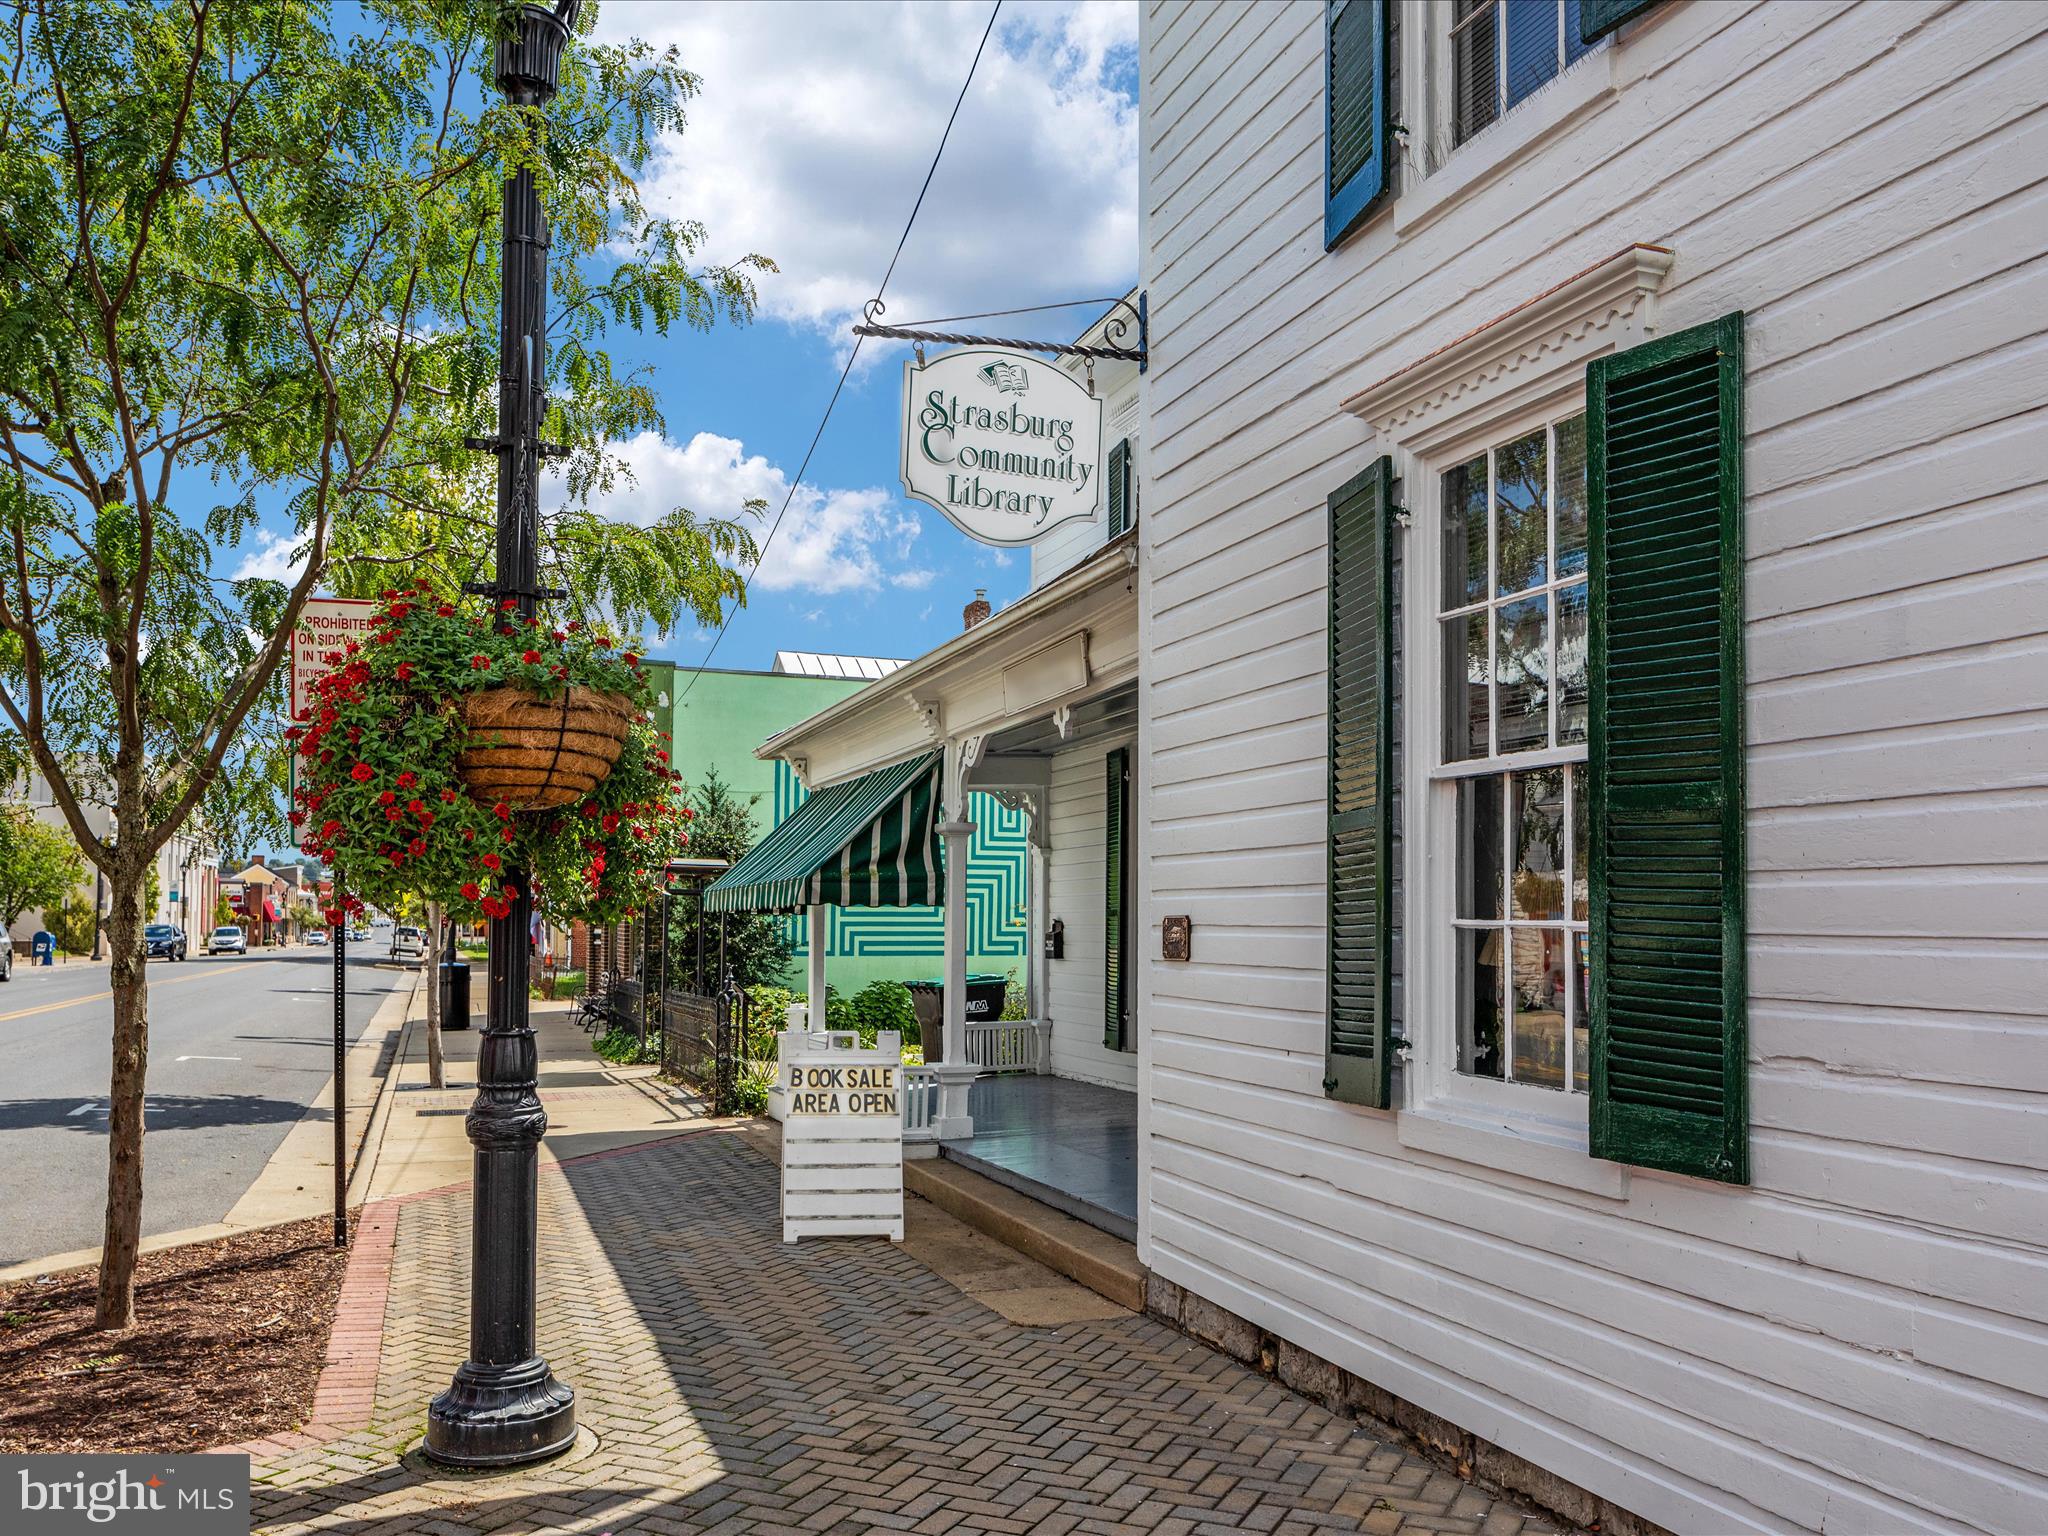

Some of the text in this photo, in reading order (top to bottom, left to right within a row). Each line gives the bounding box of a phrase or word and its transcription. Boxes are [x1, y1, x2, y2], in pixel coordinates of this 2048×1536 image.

[920, 390, 1075, 452] Strasburg
[922, 424, 1095, 492] Community
[947, 474, 1055, 526] Library
[298, 633, 315, 645] ON
[302, 650, 314, 662] IN
[791, 1067, 893, 1089] BOOK SALE
[792, 1093, 897, 1113] AREA OPEN
